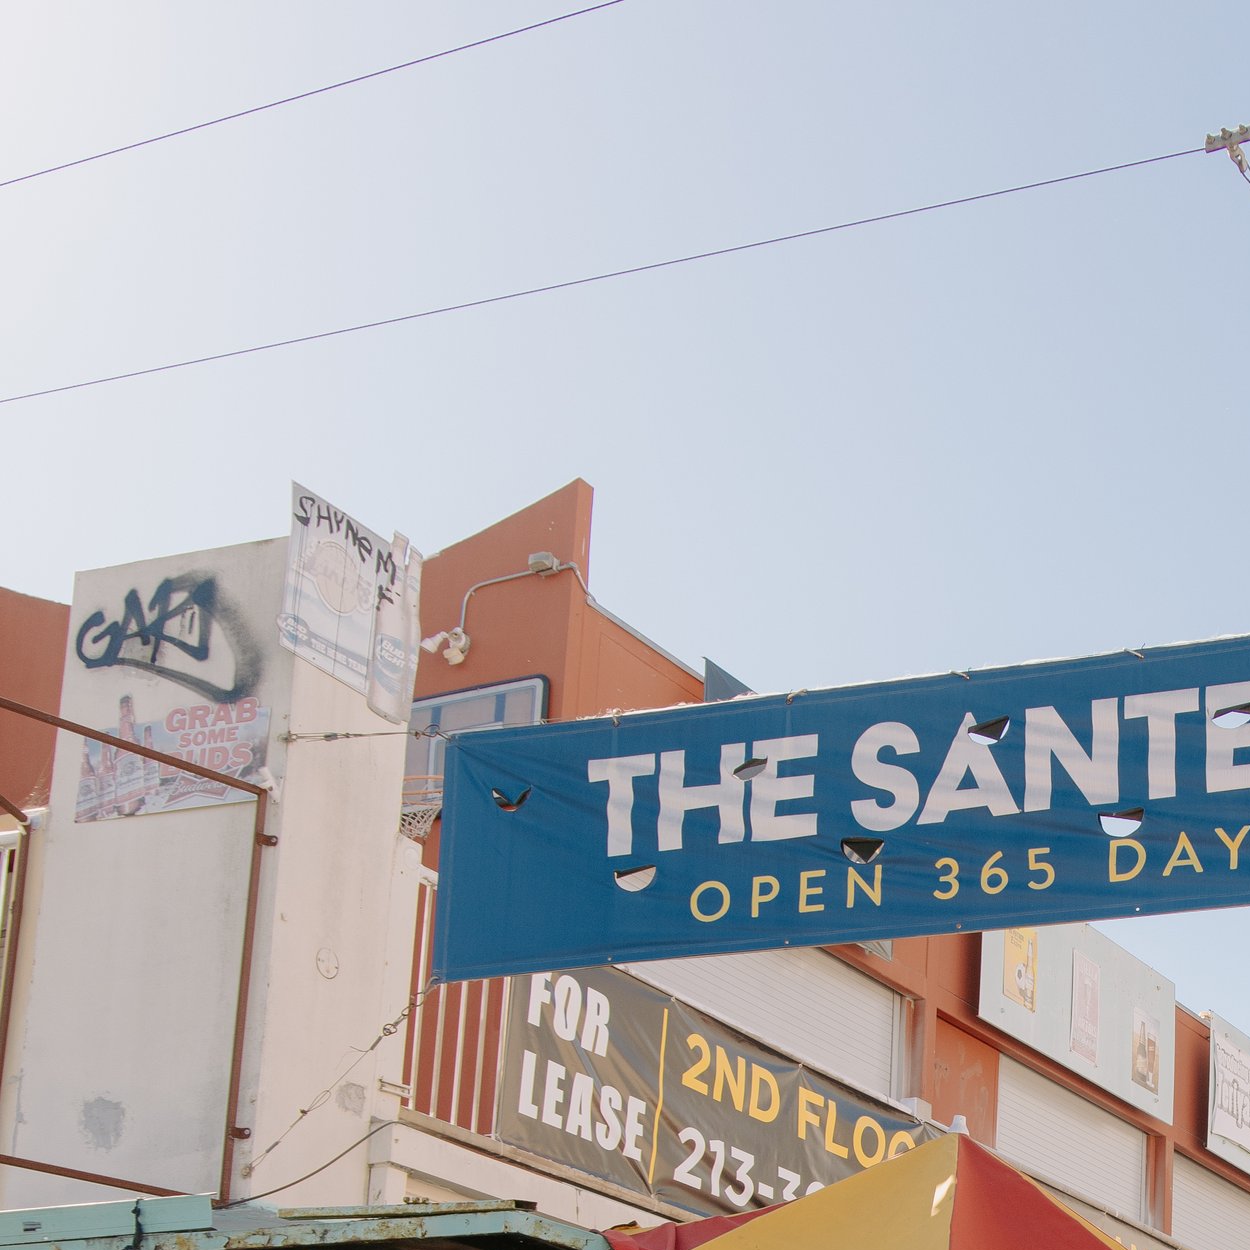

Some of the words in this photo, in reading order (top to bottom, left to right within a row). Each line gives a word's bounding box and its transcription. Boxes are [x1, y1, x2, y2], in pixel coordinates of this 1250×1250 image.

[166, 698, 259, 733] GRAB
[178, 726, 240, 749] SOME
[588, 733, 819, 857] THE
[690, 863, 884, 923] OPEN
[933, 847, 1056, 900] 365
[527, 972, 611, 1057] FOR
[518, 1050, 647, 1162] LEASE
[681, 1033, 781, 1123] 2ND
